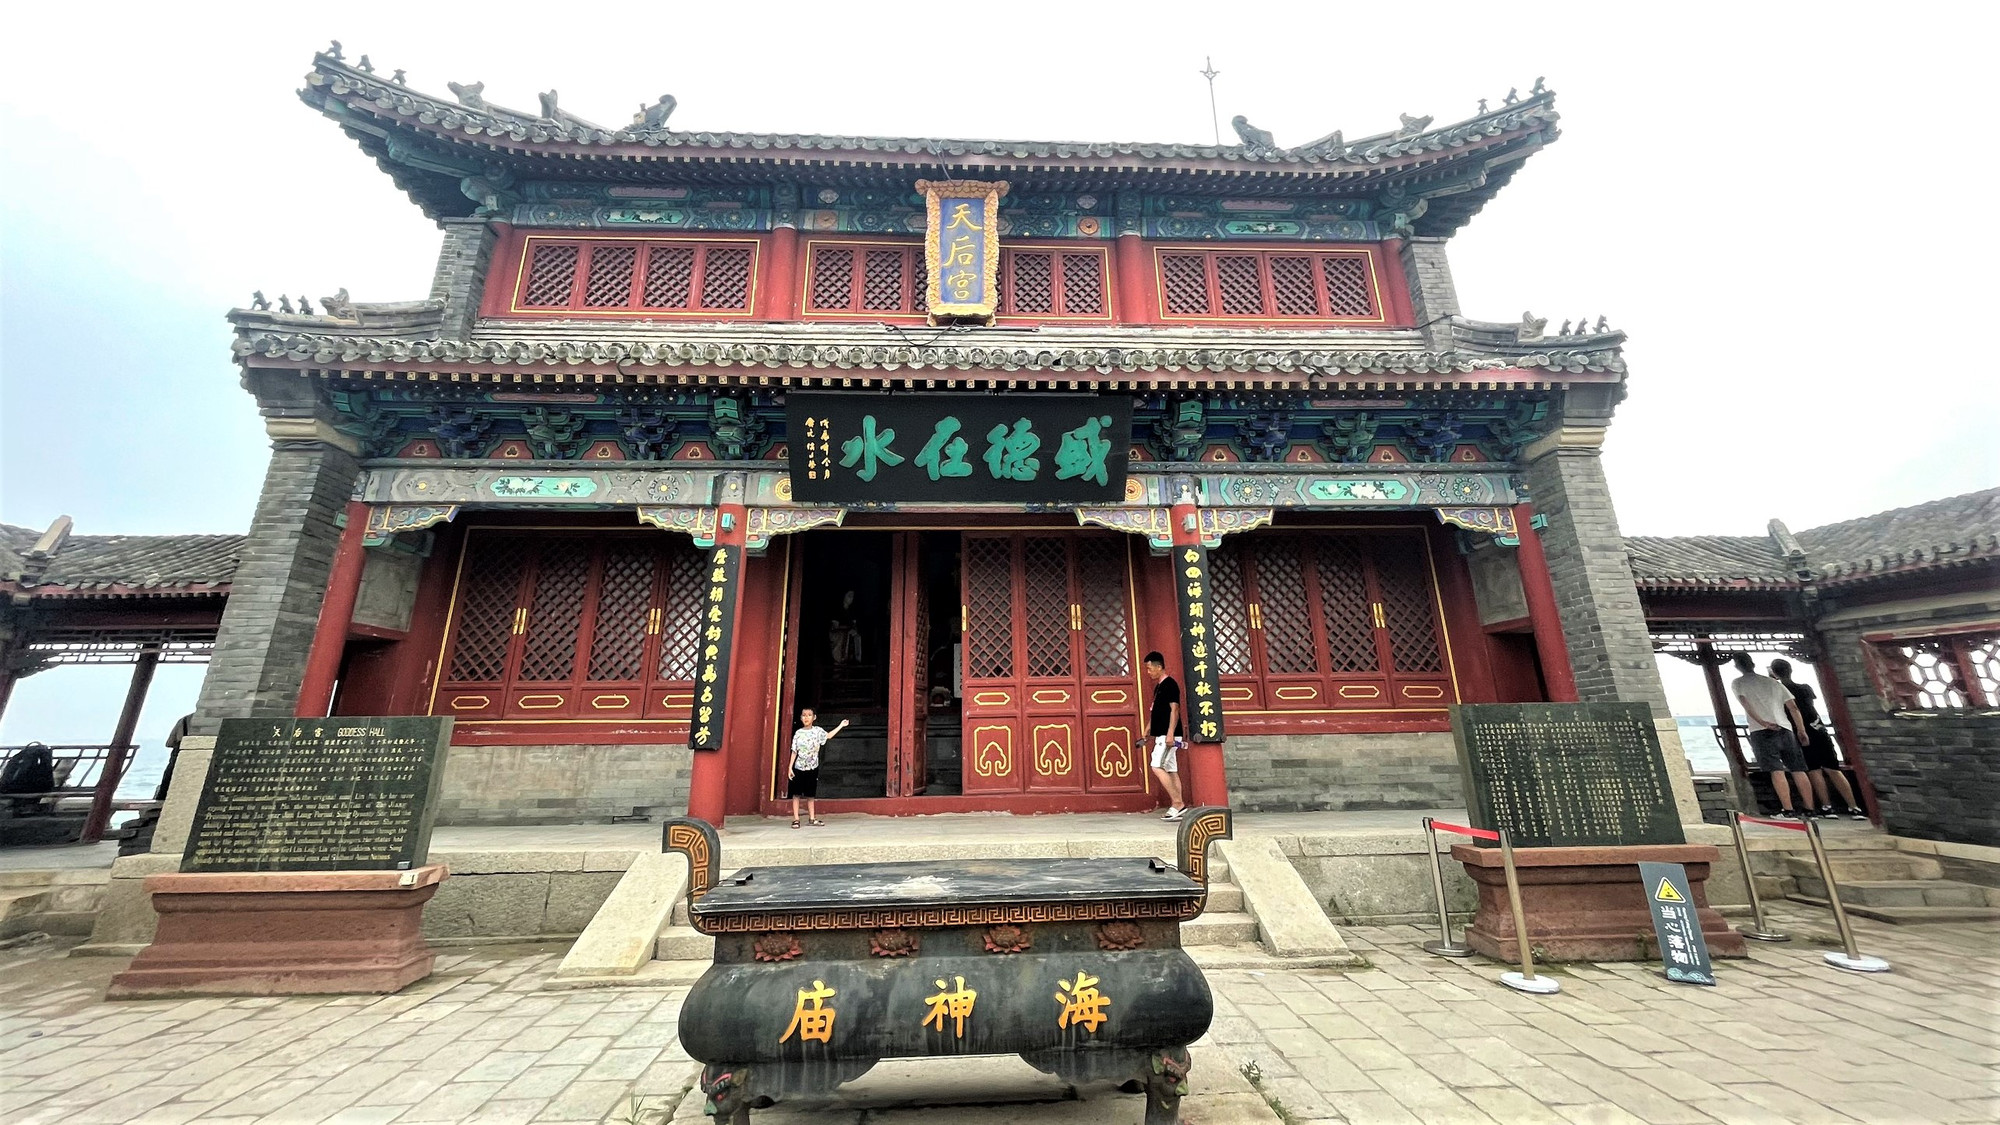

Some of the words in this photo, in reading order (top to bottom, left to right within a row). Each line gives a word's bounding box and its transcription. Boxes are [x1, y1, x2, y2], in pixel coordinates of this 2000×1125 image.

[943, 203, 982, 299] 天后宫
[337, 727, 367, 737] GODDESS
[368, 727, 385, 737] HALL
[778, 970, 1111, 1043] 海神庙
